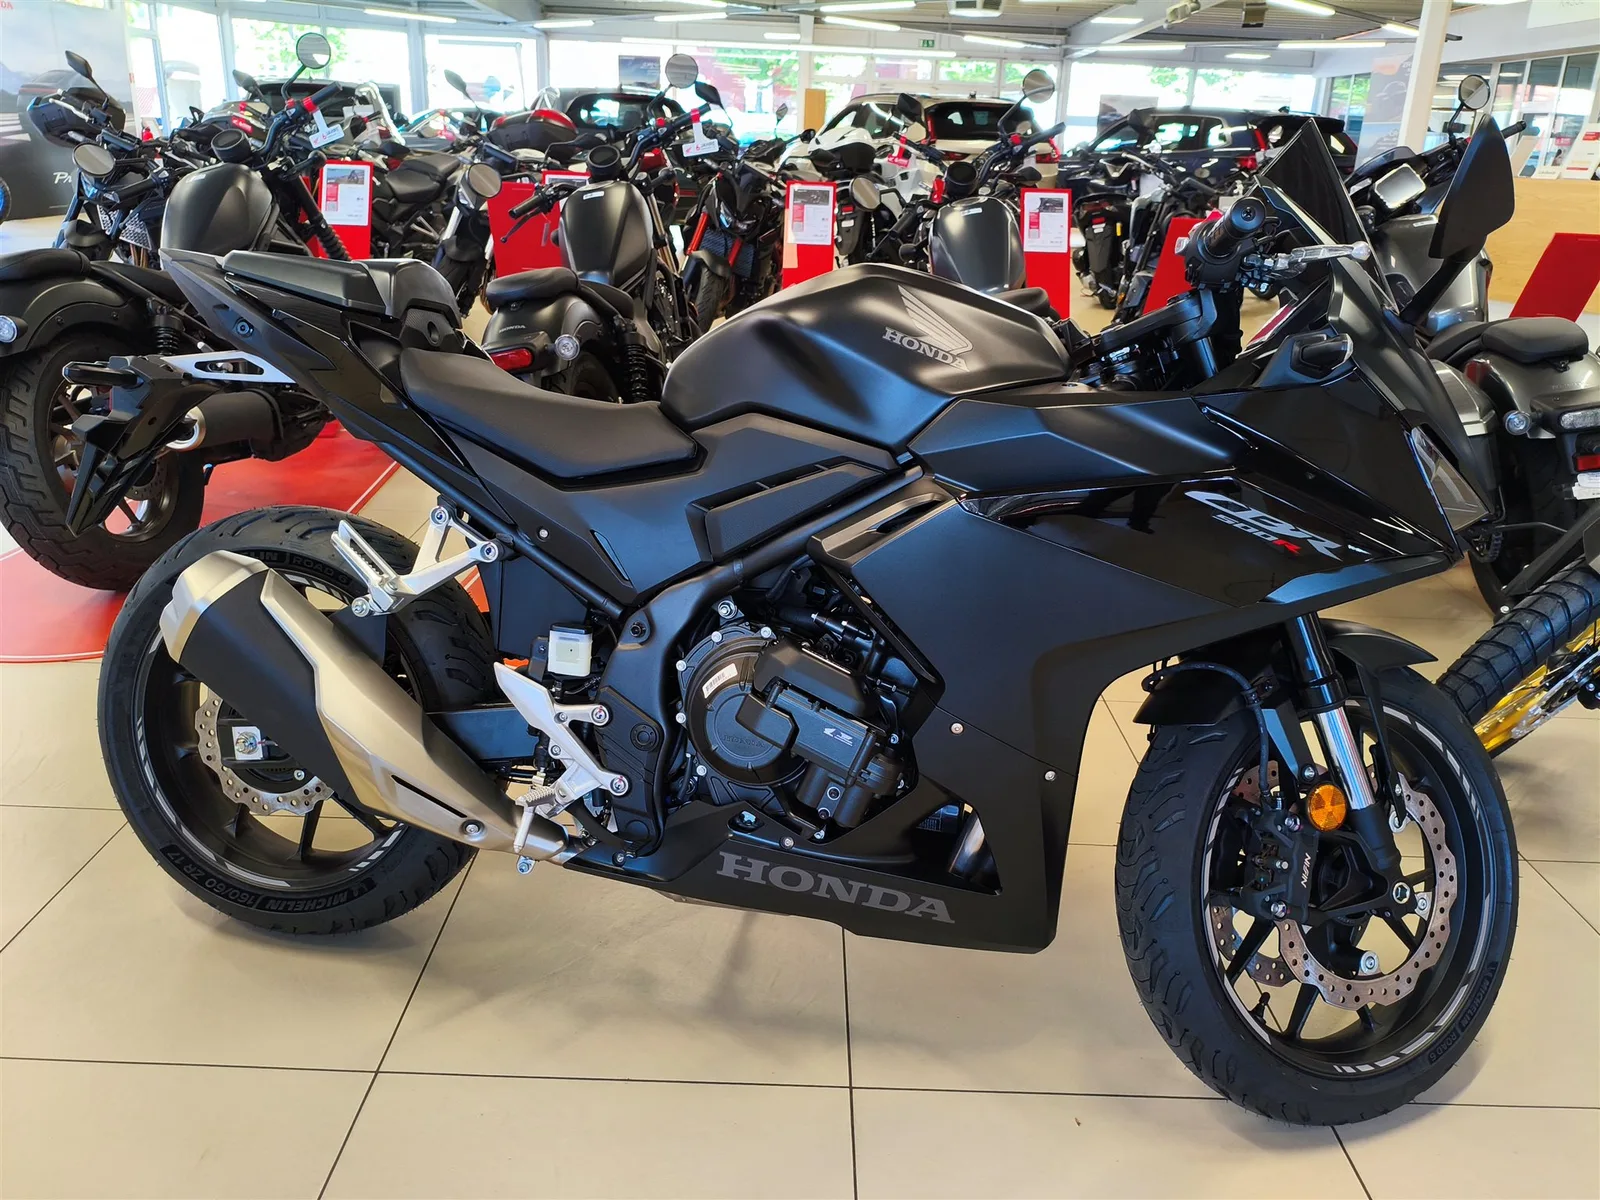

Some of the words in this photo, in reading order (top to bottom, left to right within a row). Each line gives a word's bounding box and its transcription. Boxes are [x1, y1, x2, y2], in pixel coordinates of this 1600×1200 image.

[498, 324, 527, 334] HONDA
[882, 326, 970, 372] HONDA
[1185, 490, 1344, 563] CBR
[1212, 514, 1302, 556] 500R
[292, 556, 335, 577] ROAD
[337, 574, 349, 584] 6
[166, 851, 186, 865] 17
[183, 863, 207, 879] ZR
[205, 879, 255, 907] 160/60
[265, 891, 348, 911] MICHELIN
[716, 851, 955, 923] HONDA
[1461, 977, 1491, 1027] MICHELIN
[1429, 1052, 1437, 1062] 6
[1436, 1033, 1458, 1057] ROAD
